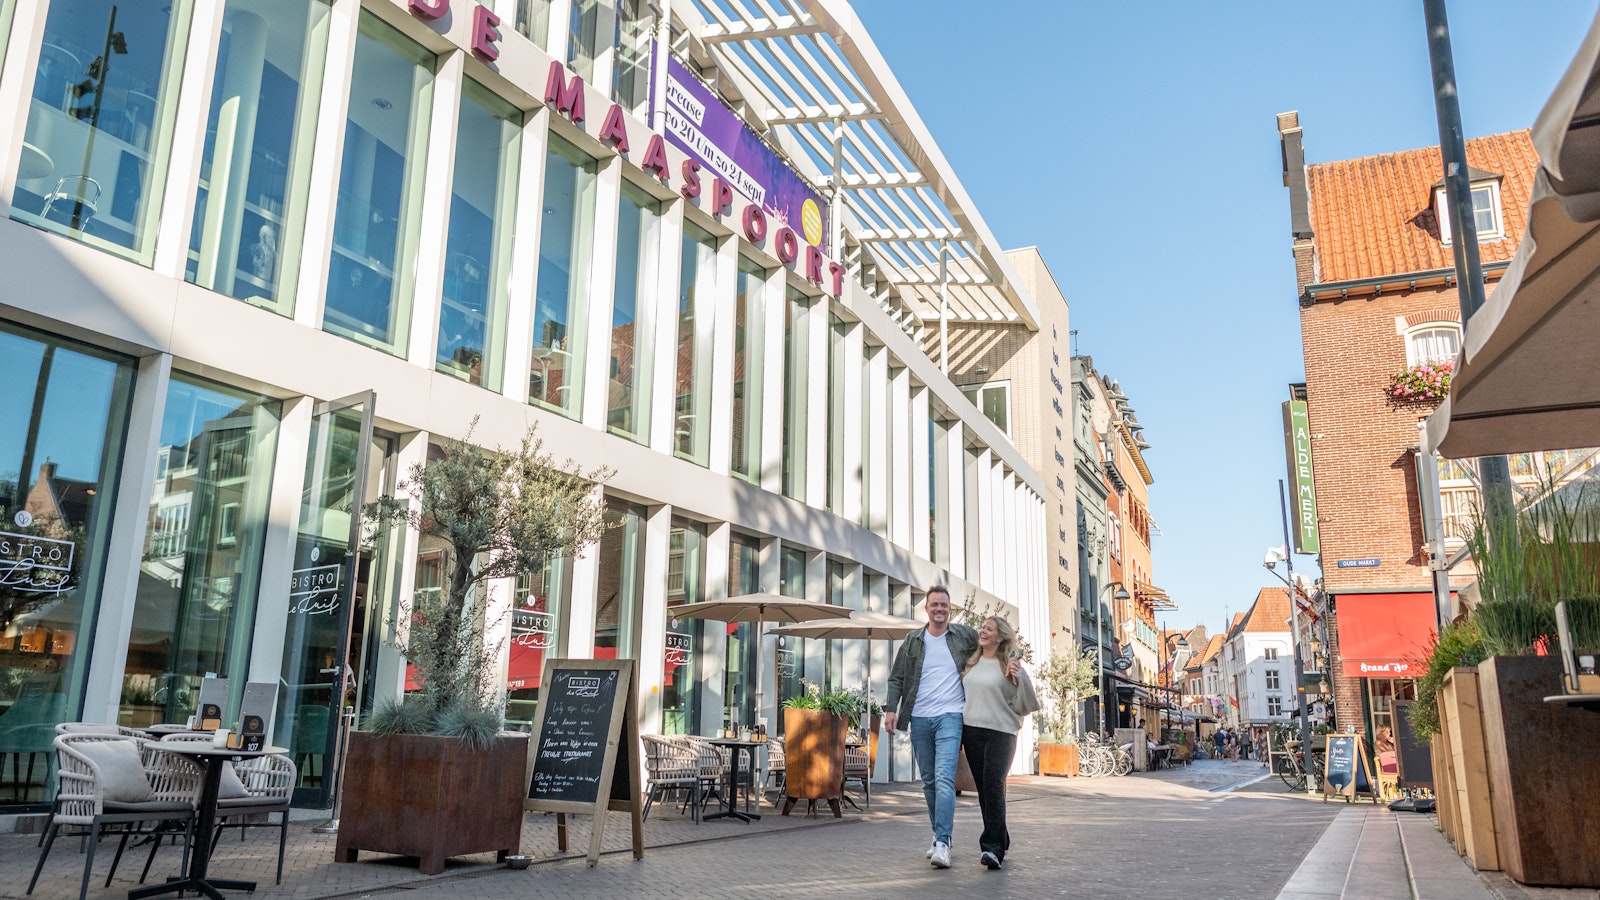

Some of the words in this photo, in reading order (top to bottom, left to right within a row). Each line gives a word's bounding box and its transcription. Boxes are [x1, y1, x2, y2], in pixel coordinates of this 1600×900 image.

[680, 121, 695, 143] 20
[729, 164, 743, 185] 24
[743, 179, 763, 202] sept
[544, 60, 847, 299] MAASPOORT
[1297, 427, 1309, 478] ALDE
[1300, 485, 1314, 538] MERT
[0, 541, 61, 561] STRO
[291, 572, 334, 589] BISTRO
[667, 636, 689, 647] STRO
[247, 743, 259, 751] 107
